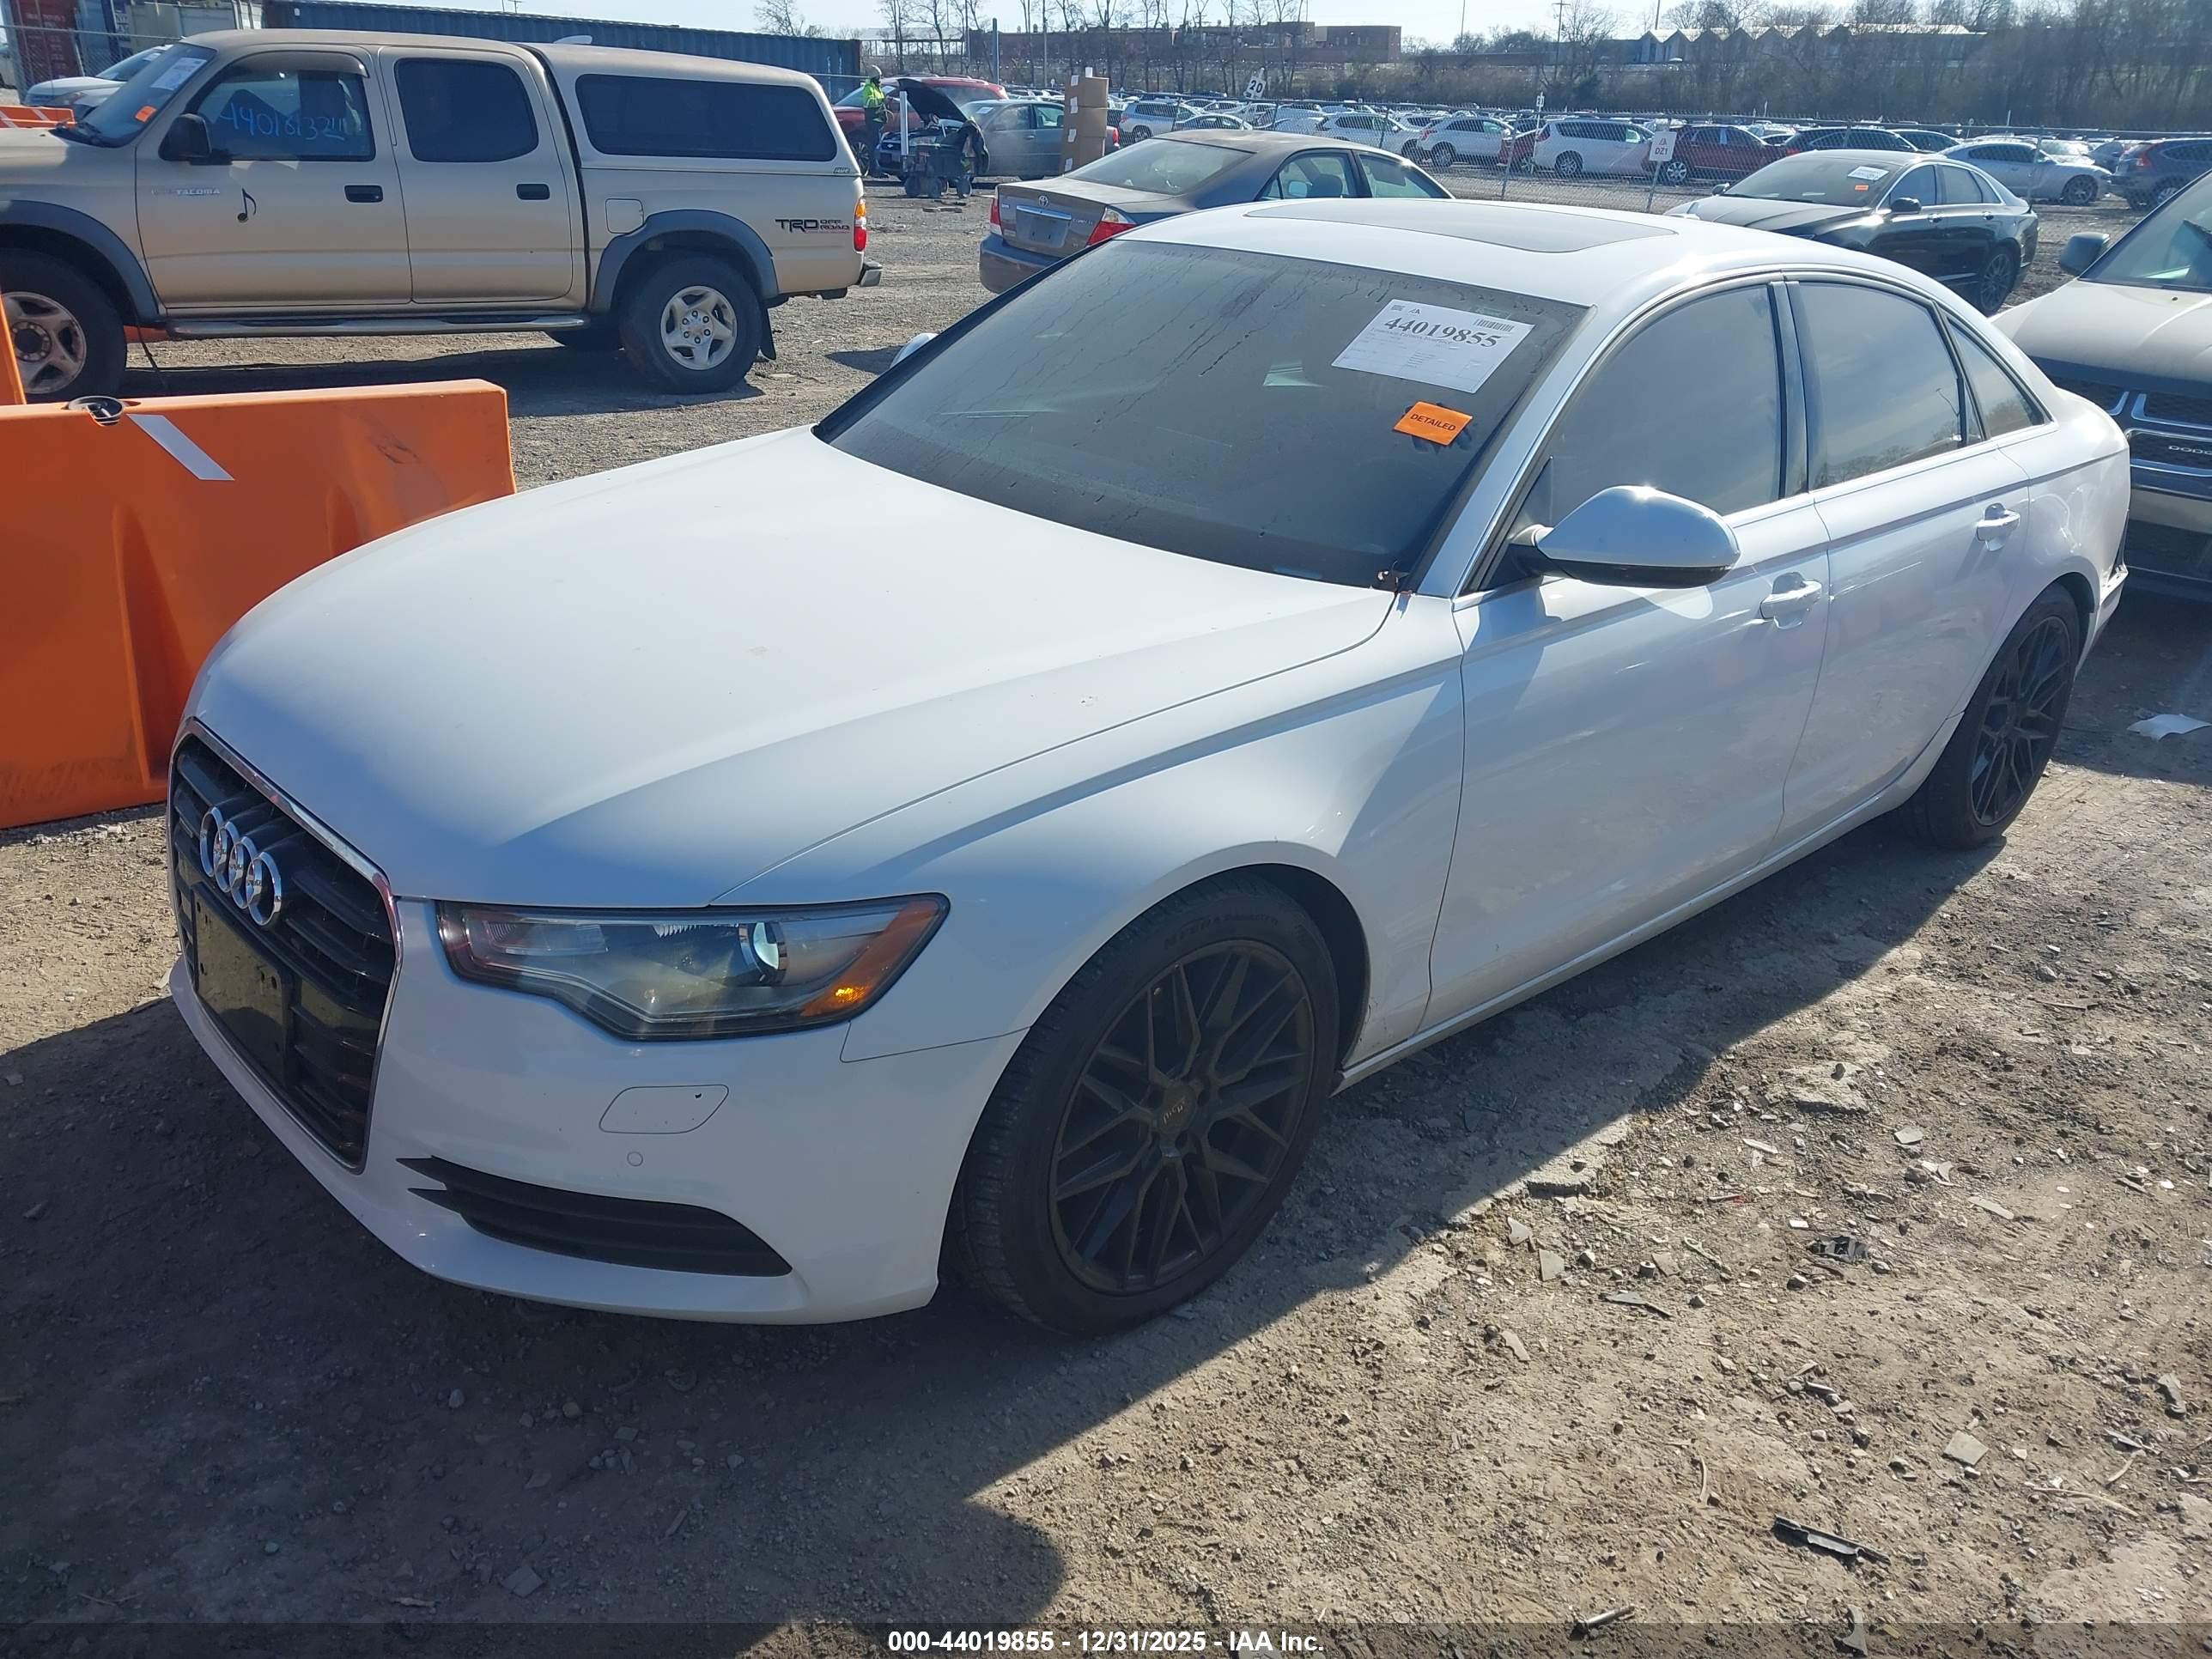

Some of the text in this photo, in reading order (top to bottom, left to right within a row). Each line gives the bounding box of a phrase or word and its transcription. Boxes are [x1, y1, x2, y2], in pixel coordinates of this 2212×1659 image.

[1249, 80, 1263, 94] 20
[775, 219, 818, 233] TRD
[1383, 317, 1502, 348] 44019855
[1410, 413, 1456, 432] DETAILED
